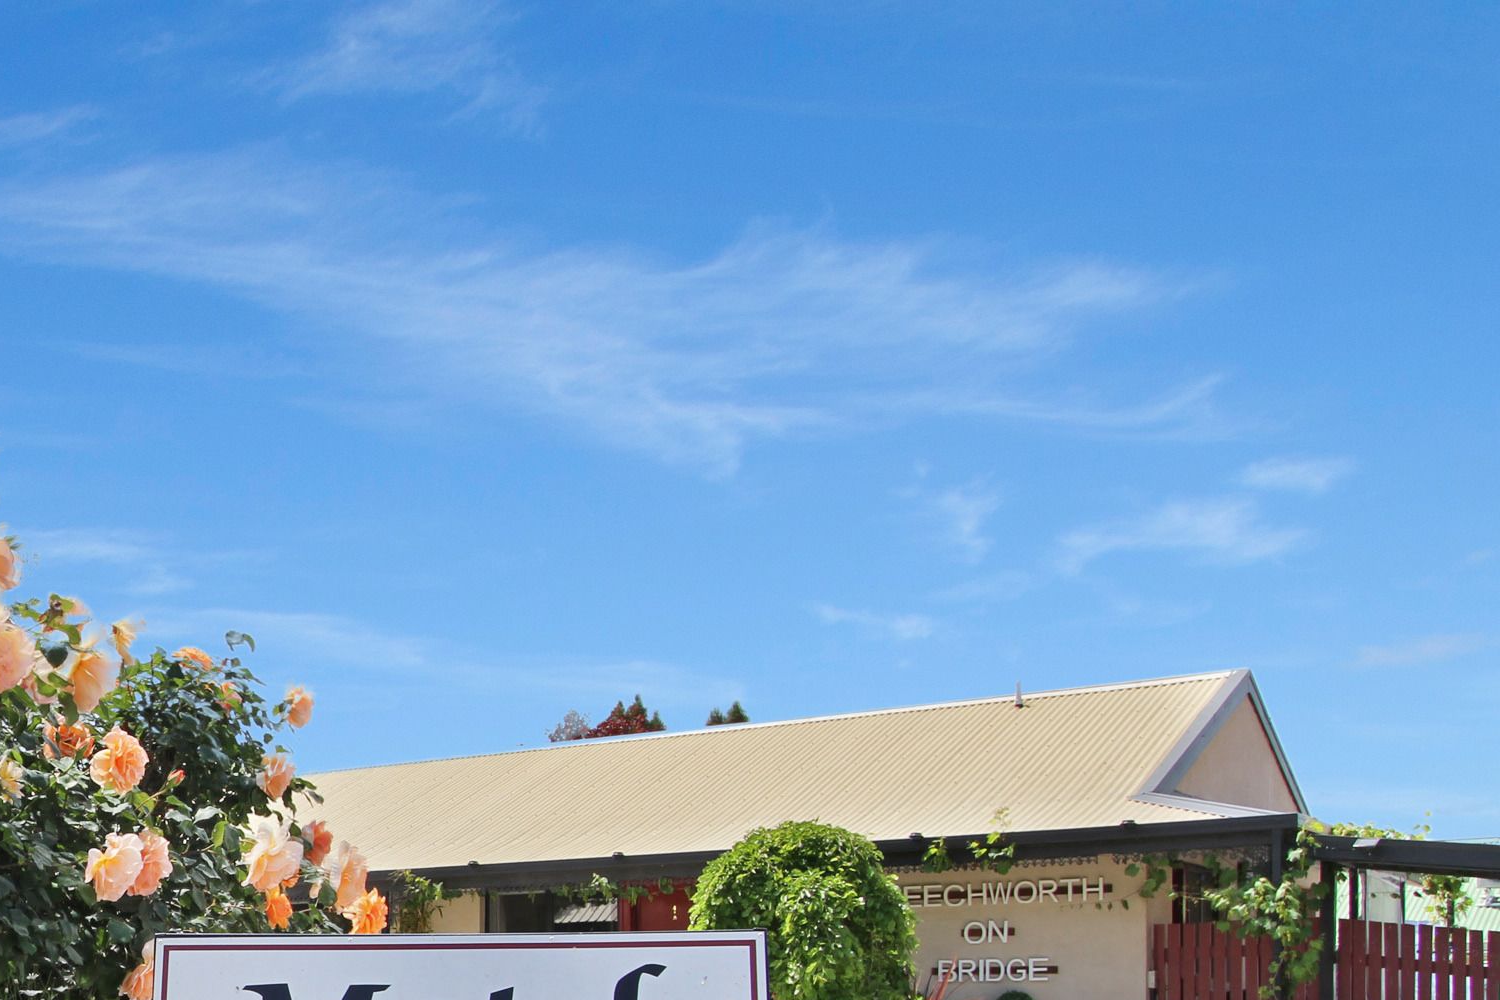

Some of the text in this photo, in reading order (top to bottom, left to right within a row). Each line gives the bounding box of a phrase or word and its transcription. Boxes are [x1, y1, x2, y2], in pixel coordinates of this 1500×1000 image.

[903, 877, 1104, 908] EECHWORTH
[963, 920, 1009, 945] ON
[937, 957, 1049, 983] BRIDGE
